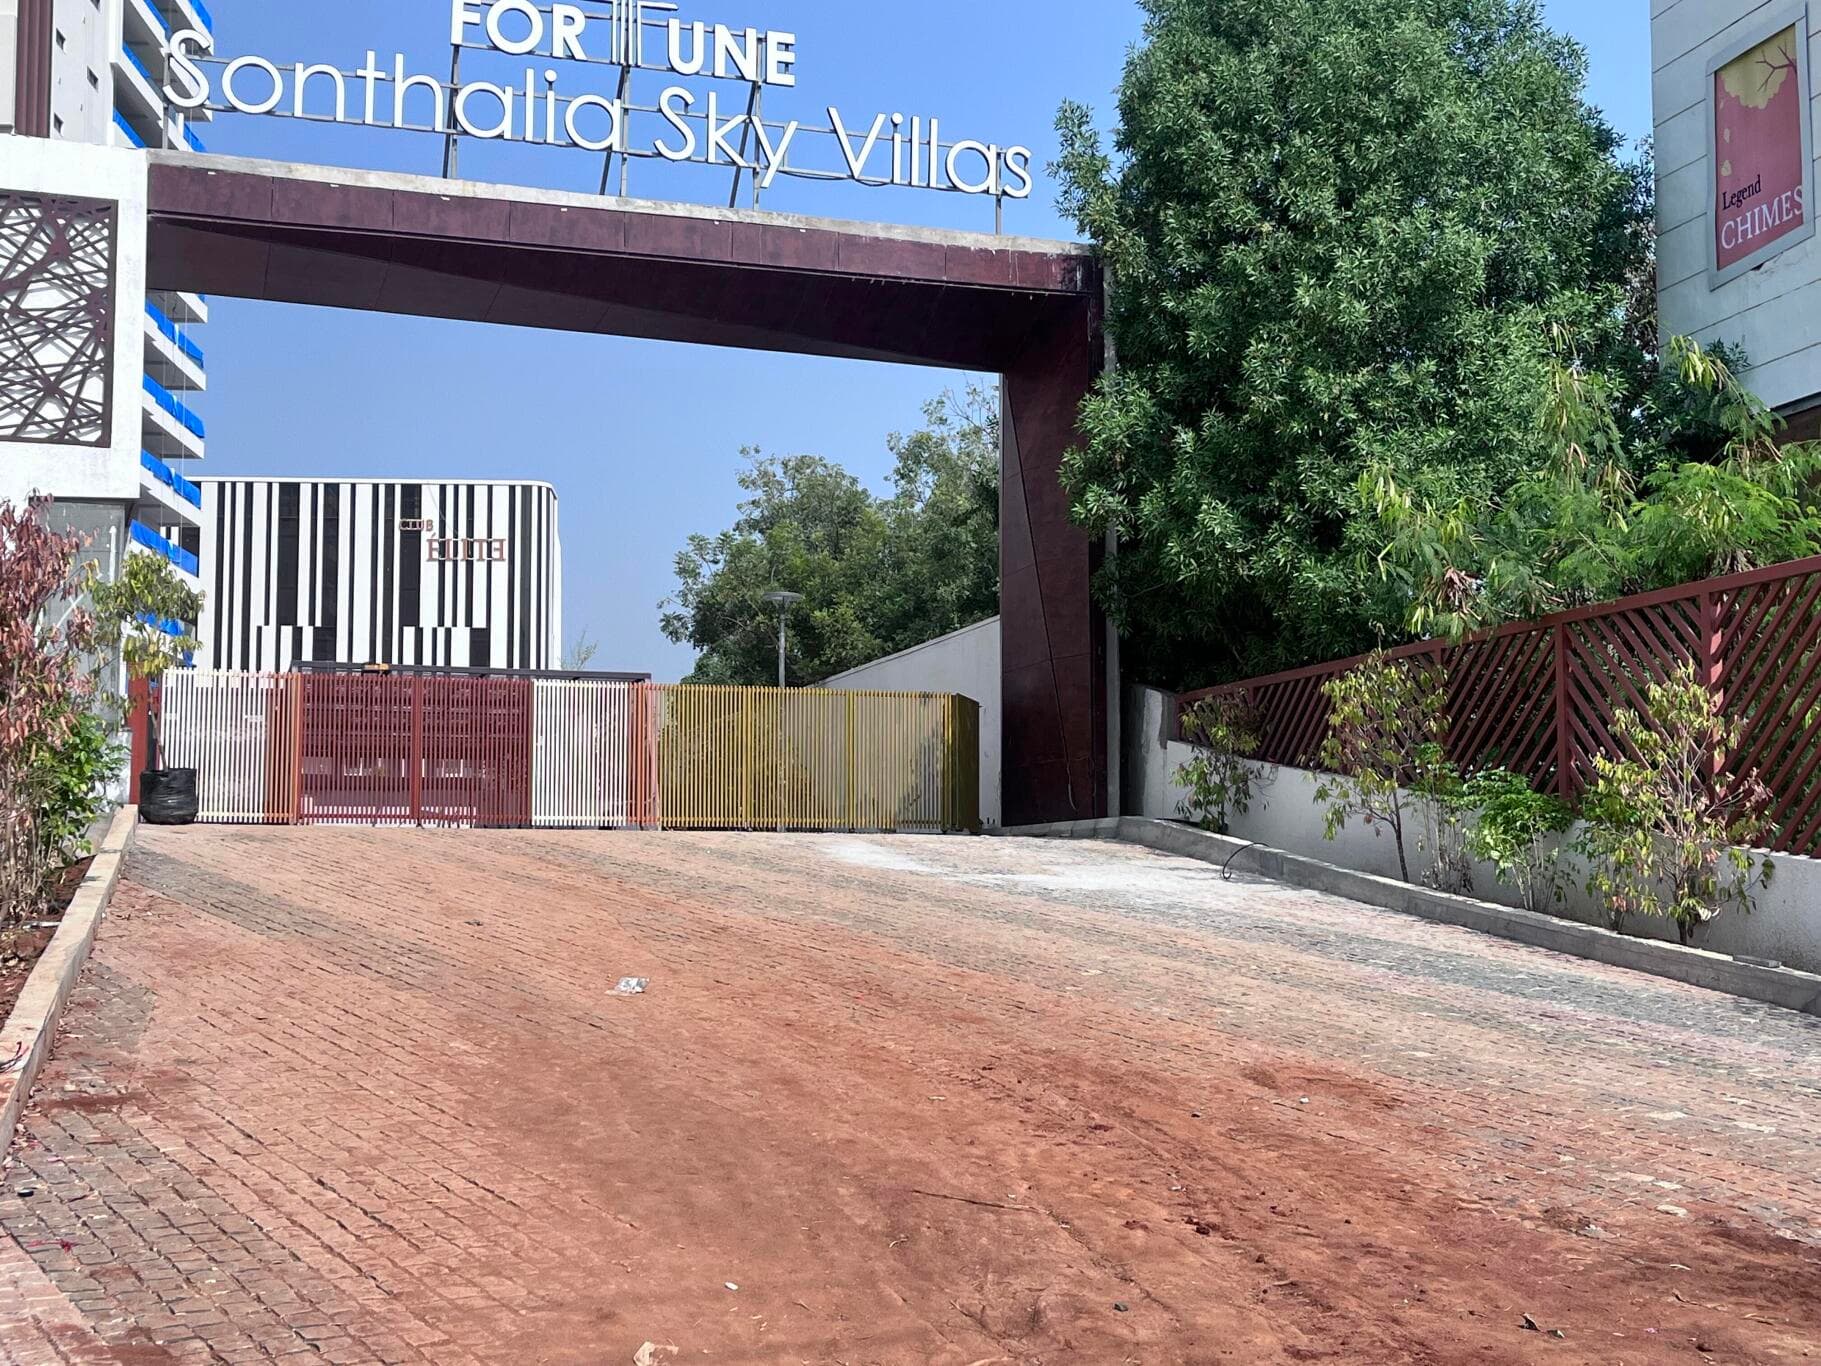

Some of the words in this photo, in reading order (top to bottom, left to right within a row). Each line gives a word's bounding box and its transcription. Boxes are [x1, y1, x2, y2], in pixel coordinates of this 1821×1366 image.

[164, 28, 623, 152] Sonthalia
[654, 86, 799, 188] Sky
[826, 105, 1033, 199] Villas
[1721, 186, 1803, 249] CHIMES
[1722, 174, 1762, 210] Legend
